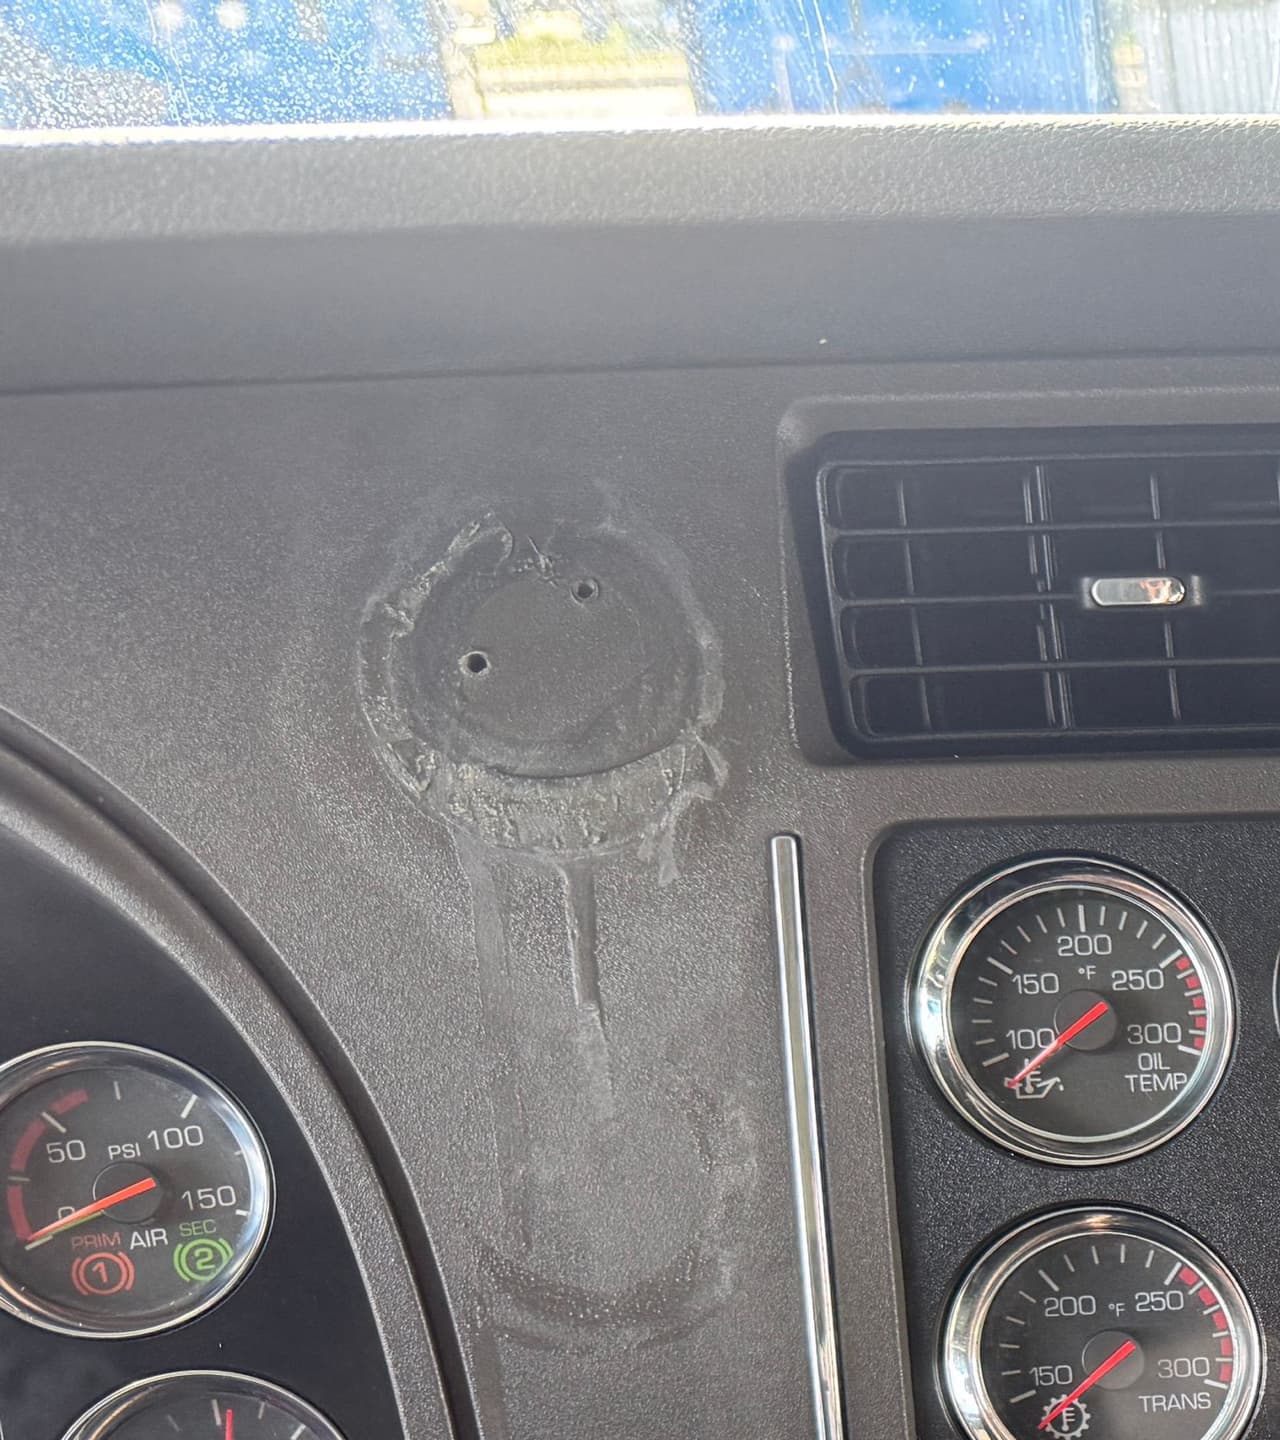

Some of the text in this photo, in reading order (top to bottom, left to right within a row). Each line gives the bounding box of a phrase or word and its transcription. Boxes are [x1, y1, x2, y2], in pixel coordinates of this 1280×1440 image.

[1057, 934, 1112, 957] 200
[1011, 972, 1060, 996] 150
[1111, 968, 1164, 991] 250
[1005, 1029, 1056, 1051] 100
[1127, 1022, 1182, 1045] 300
[1138, 1052, 1171, 1073] OIL
[1125, 1072, 1189, 1095] TEMP
[147, 1125, 204, 1150] 100
[47, 1139, 86, 1163] 50
[107, 1143, 141, 1160] PSI
[181, 1185, 237, 1211] 150
[130, 1228, 169, 1250] AIR
[179, 1219, 217, 1238] SEC
[72, 1232, 121, 1249] PRIM
[1043, 1296, 1097, 1318] 200
[1134, 1291, 1185, 1313] 250
[1030, 1365, 1073, 1387] 150
[1157, 1357, 1211, 1379] 300
[1138, 1392, 1212, 1413] TRANS
